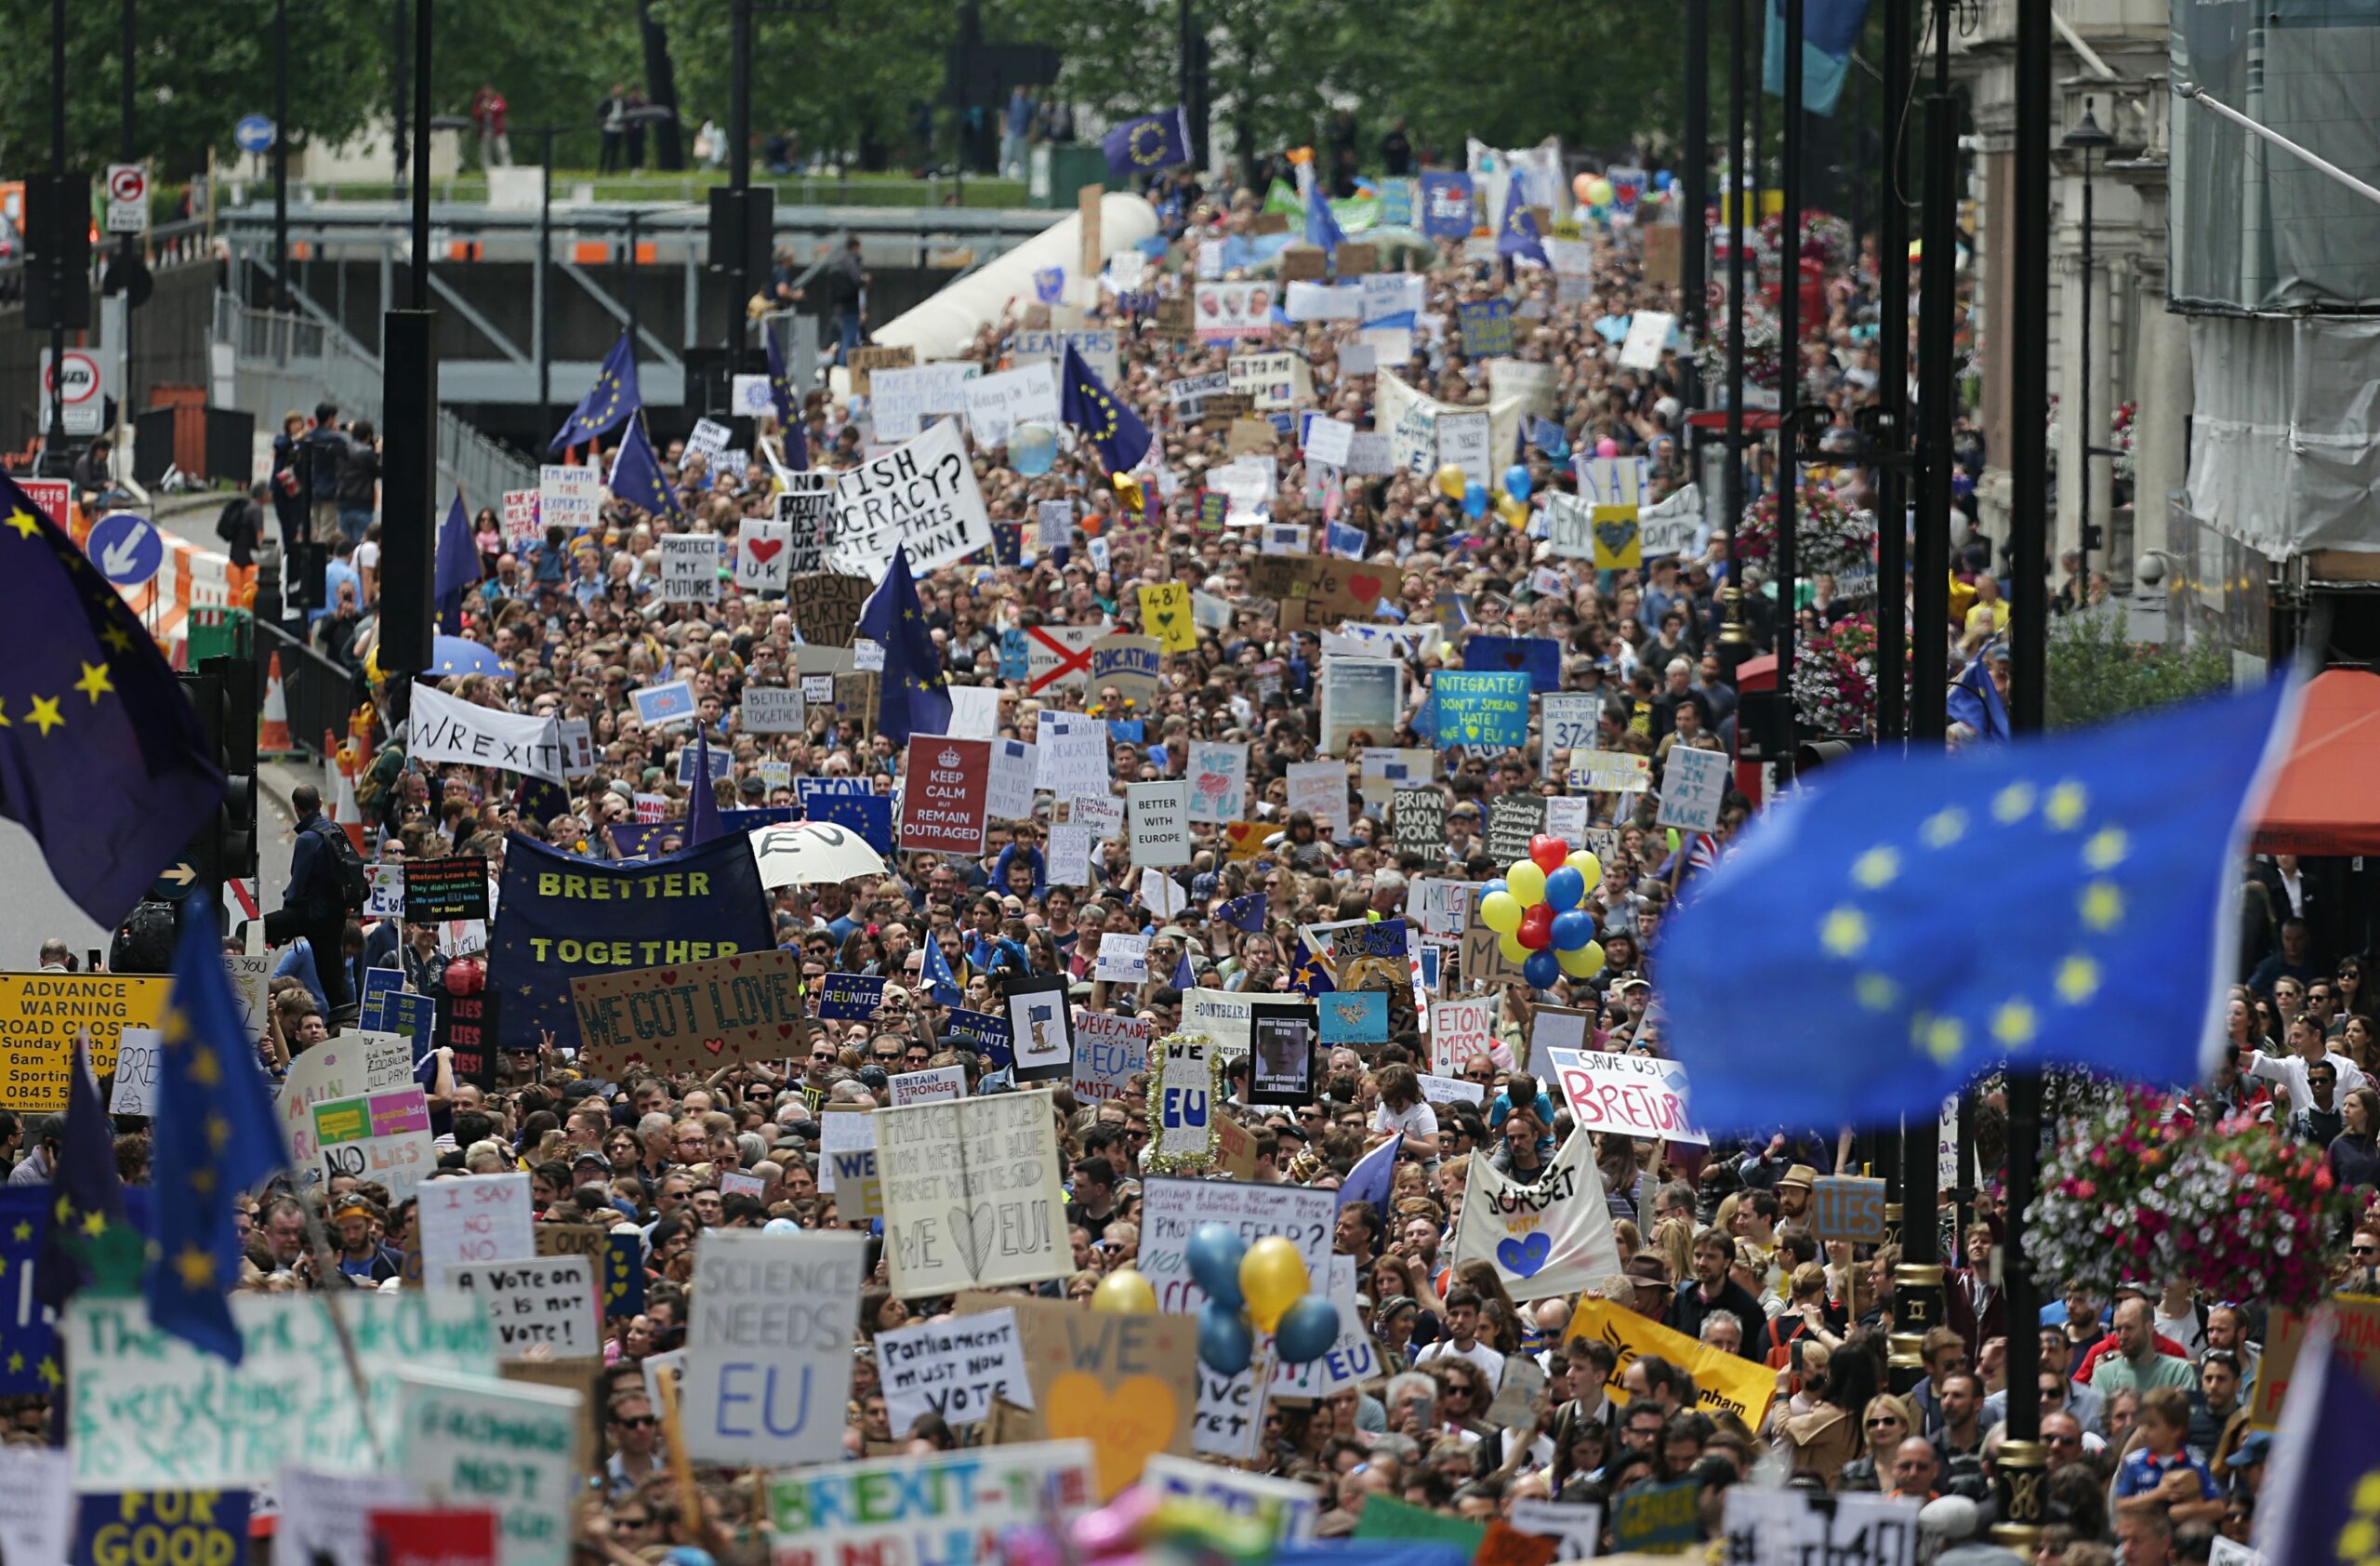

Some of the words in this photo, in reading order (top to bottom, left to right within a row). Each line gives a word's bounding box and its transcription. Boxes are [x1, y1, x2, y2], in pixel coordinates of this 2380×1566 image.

[563, 469, 593, 483] WITH
[560, 484, 578, 495] THE
[896, 503, 953, 537] THIS
[662, 540, 716, 556] PROTECT
[674, 562, 697, 576] MY
[665, 578, 715, 599] FUTURE
[794, 574, 870, 604] BREXIT
[1148, 589, 1183, 606] 48%
[1066, 630, 1083, 643] NO
[1093, 649, 1159, 671] EDUCATION
[749, 692, 799, 707] BETTER
[1481, 698, 1518, 712] SPREAD
[747, 706, 803, 723] TOGETHER
[410, 712, 560, 777] WREXIT
[1554, 723, 1593, 748] 37%
[1199, 751, 1236, 774] WE
[930, 770, 964, 784] KEEP
[1681, 767, 1704, 784] IN
[800, 777, 870, 795] ETON
[926, 785, 966, 800] CALM
[1076, 796, 1107, 808] BRITAIN
[1138, 798, 1177, 811] BETTER
[1190, 793, 1237, 816] EU
[1395, 791, 1445, 810] BRITAIN
[1491, 795, 1542, 818] Solidarity
[917, 809, 970, 825] REMAIN
[1074, 811, 1083, 820] IN
[1075, 803, 1119, 818] STRONGER
[1395, 810, 1440, 825] KNOW
[1661, 801, 1709, 828] NAME
[1144, 816, 1173, 827] WITH
[904, 824, 980, 841] OUTRAGED
[1138, 832, 1181, 844] EUROPE
[1395, 826, 1440, 842] YOUR
[409, 872, 443, 881] Whatever
[538, 871, 710, 899] BRETTER
[410, 884, 429, 894] They
[430, 883, 449, 891] didn't
[427, 895, 446, 903] want
[447, 893, 462, 902] EU
[444, 905, 465, 914] good!
[530, 937, 740, 965] TOGETHER
[1101, 936, 1144, 954] UNITED
[1339, 939, 1390, 957] ALWAYS
[241, 958, 267, 974] YOU
[21, 982, 127, 998] ADVANCE
[824, 989, 881, 1006] REUNITE
[20, 1001, 127, 1017] WARNING
[452, 998, 483, 1019] LIES
[713, 972, 799, 1030] LOVE
[1438, 1005, 1488, 1032] ETON
[450, 1025, 482, 1046] LIES
[1115, 1020, 1150, 1040] MADE
[2, 1036, 61, 1053] Sunday
[1168, 1044, 1205, 1060] WE
[1435, 1033, 1484, 1065] MESS
[10, 1054, 44, 1066] 6am
[1579, 1051, 1625, 1071] SAVE
[1633, 1057, 1663, 1078] US!
[895, 1072, 939, 1088] BRITAIN
[7, 1086, 48, 1098] 0845
[896, 1081, 959, 1098] STRONGER
[1163, 1087, 1207, 1129] EU
[882, 1104, 956, 1145] FARAGE
[1007, 1096, 1047, 1128] RED
[370, 1140, 419, 1170] LIES
[886, 1150, 919, 1175] NOW
[975, 1136, 1002, 1164] ALL
[1005, 1129, 1047, 1160] BLUE
[836, 1150, 877, 1179] WE
[888, 1174, 941, 1203] FORGET
[988, 1166, 1007, 1192] HE
[1009, 1160, 1044, 1189] SAID
[445, 1188, 461, 1209] I
[473, 1186, 518, 1204] SAY
[464, 1214, 492, 1235] NO
[1506, 1215, 1540, 1233] WITH
[1818, 1194, 1884, 1237] LIES
[555, 1231, 600, 1255] OUR
[892, 1217, 942, 1270] WE
[999, 1199, 1051, 1256] EU!
[460, 1240, 497, 1262] NO
[701, 1257, 855, 1296] SCIENCE
[704, 1305, 845, 1353] NEEDS
[883, 1324, 1012, 1367] Parliament
[1066, 1316, 1151, 1374] WE
[1325, 1342, 1371, 1383] EU
[716, 1361, 813, 1438] EU
[91, 1525, 236, 1566] GOOD
